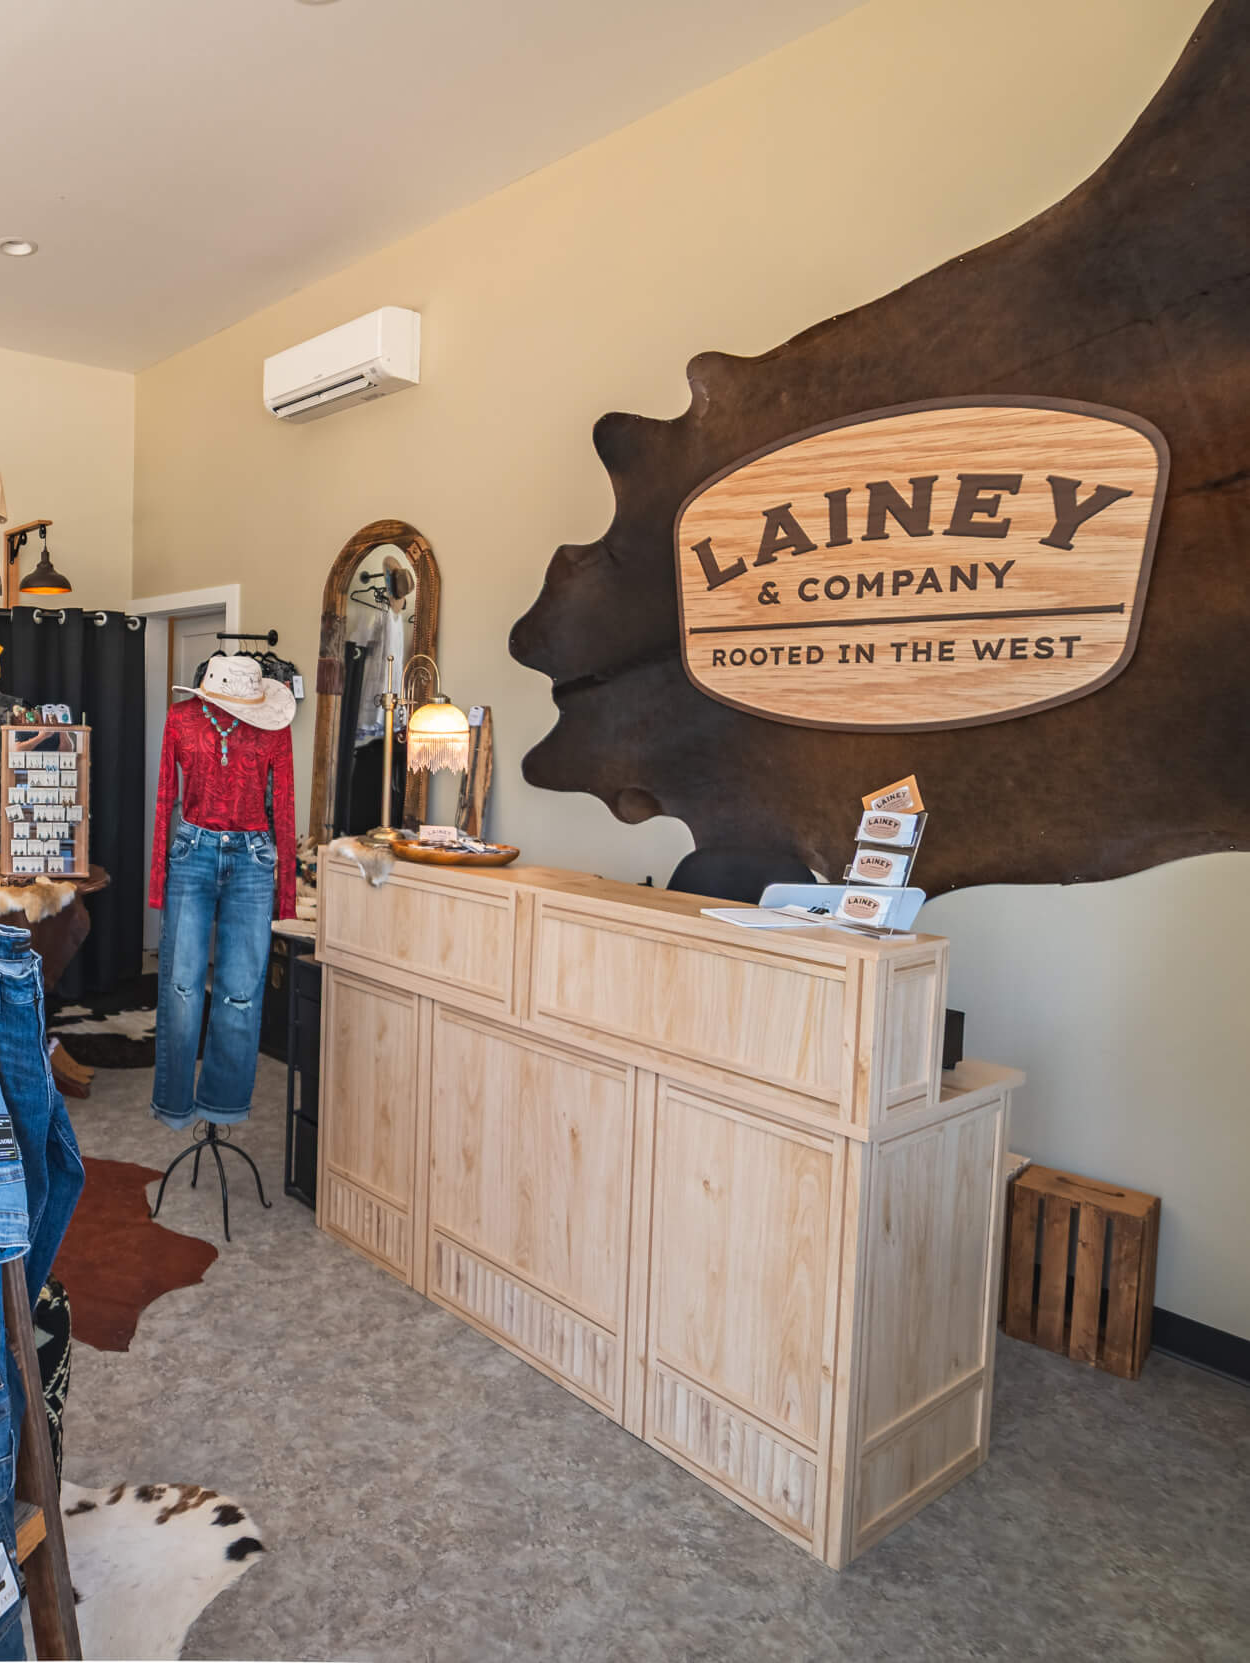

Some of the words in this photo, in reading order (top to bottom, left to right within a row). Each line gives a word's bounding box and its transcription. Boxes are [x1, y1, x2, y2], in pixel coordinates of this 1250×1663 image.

[691, 473, 1133, 591] LAINEY
[757, 580, 781, 605] &
[797, 560, 1016, 603] COMPANY
[712, 644, 825, 667] ROOTED
[838, 643, 876, 664] IN
[891, 640, 956, 663] THE
[972, 635, 1082, 661] WEST
[876, 791, 907, 809] LAINEY
[868, 818, 900, 829] LAINEY
[860, 858, 892, 869] LAINEY
[848, 897, 878, 909] LAINEY
